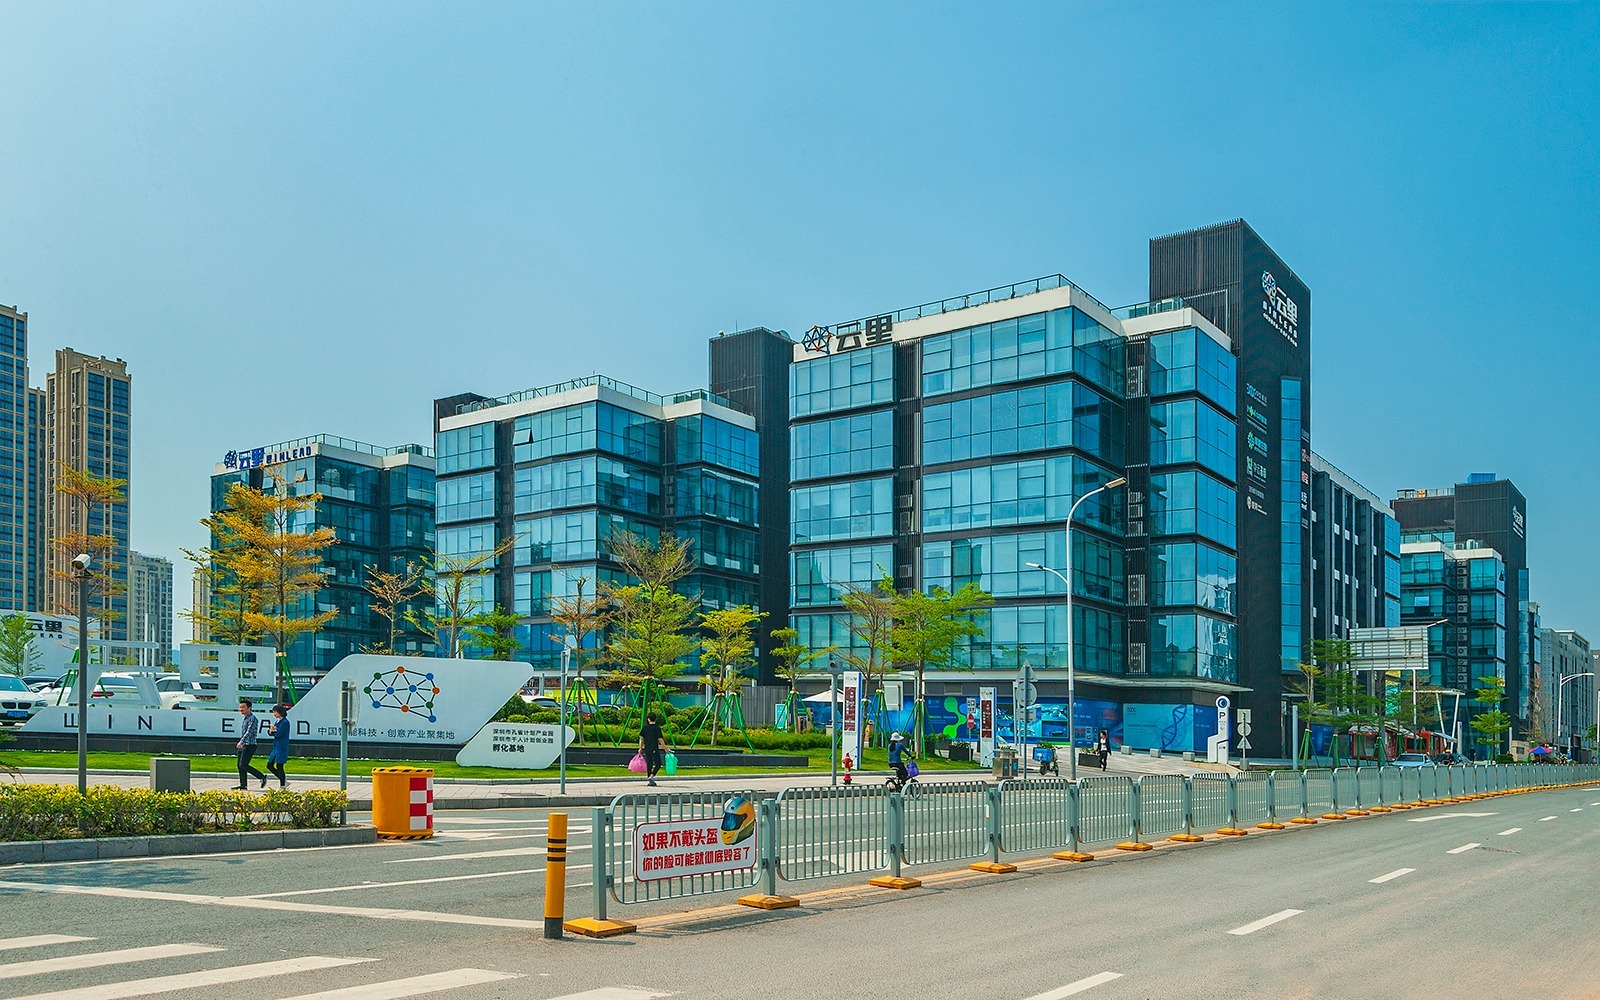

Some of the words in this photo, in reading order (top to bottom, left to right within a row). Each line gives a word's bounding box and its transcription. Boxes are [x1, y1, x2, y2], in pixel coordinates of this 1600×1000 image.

[836, 314, 893, 352] 云里
[26, 618, 63, 633] 云里
[64, 713, 311, 735] WINLEAD
[1219, 711, 1227, 720] P
[317, 726, 456, 740] 中国能科技·创意产业聚集地
[492, 743, 525, 753] 孵化基地
[643, 828, 718, 851] 如果不戴头盔
[643, 847, 750, 871] 你的脸可能就彻底毁容了
